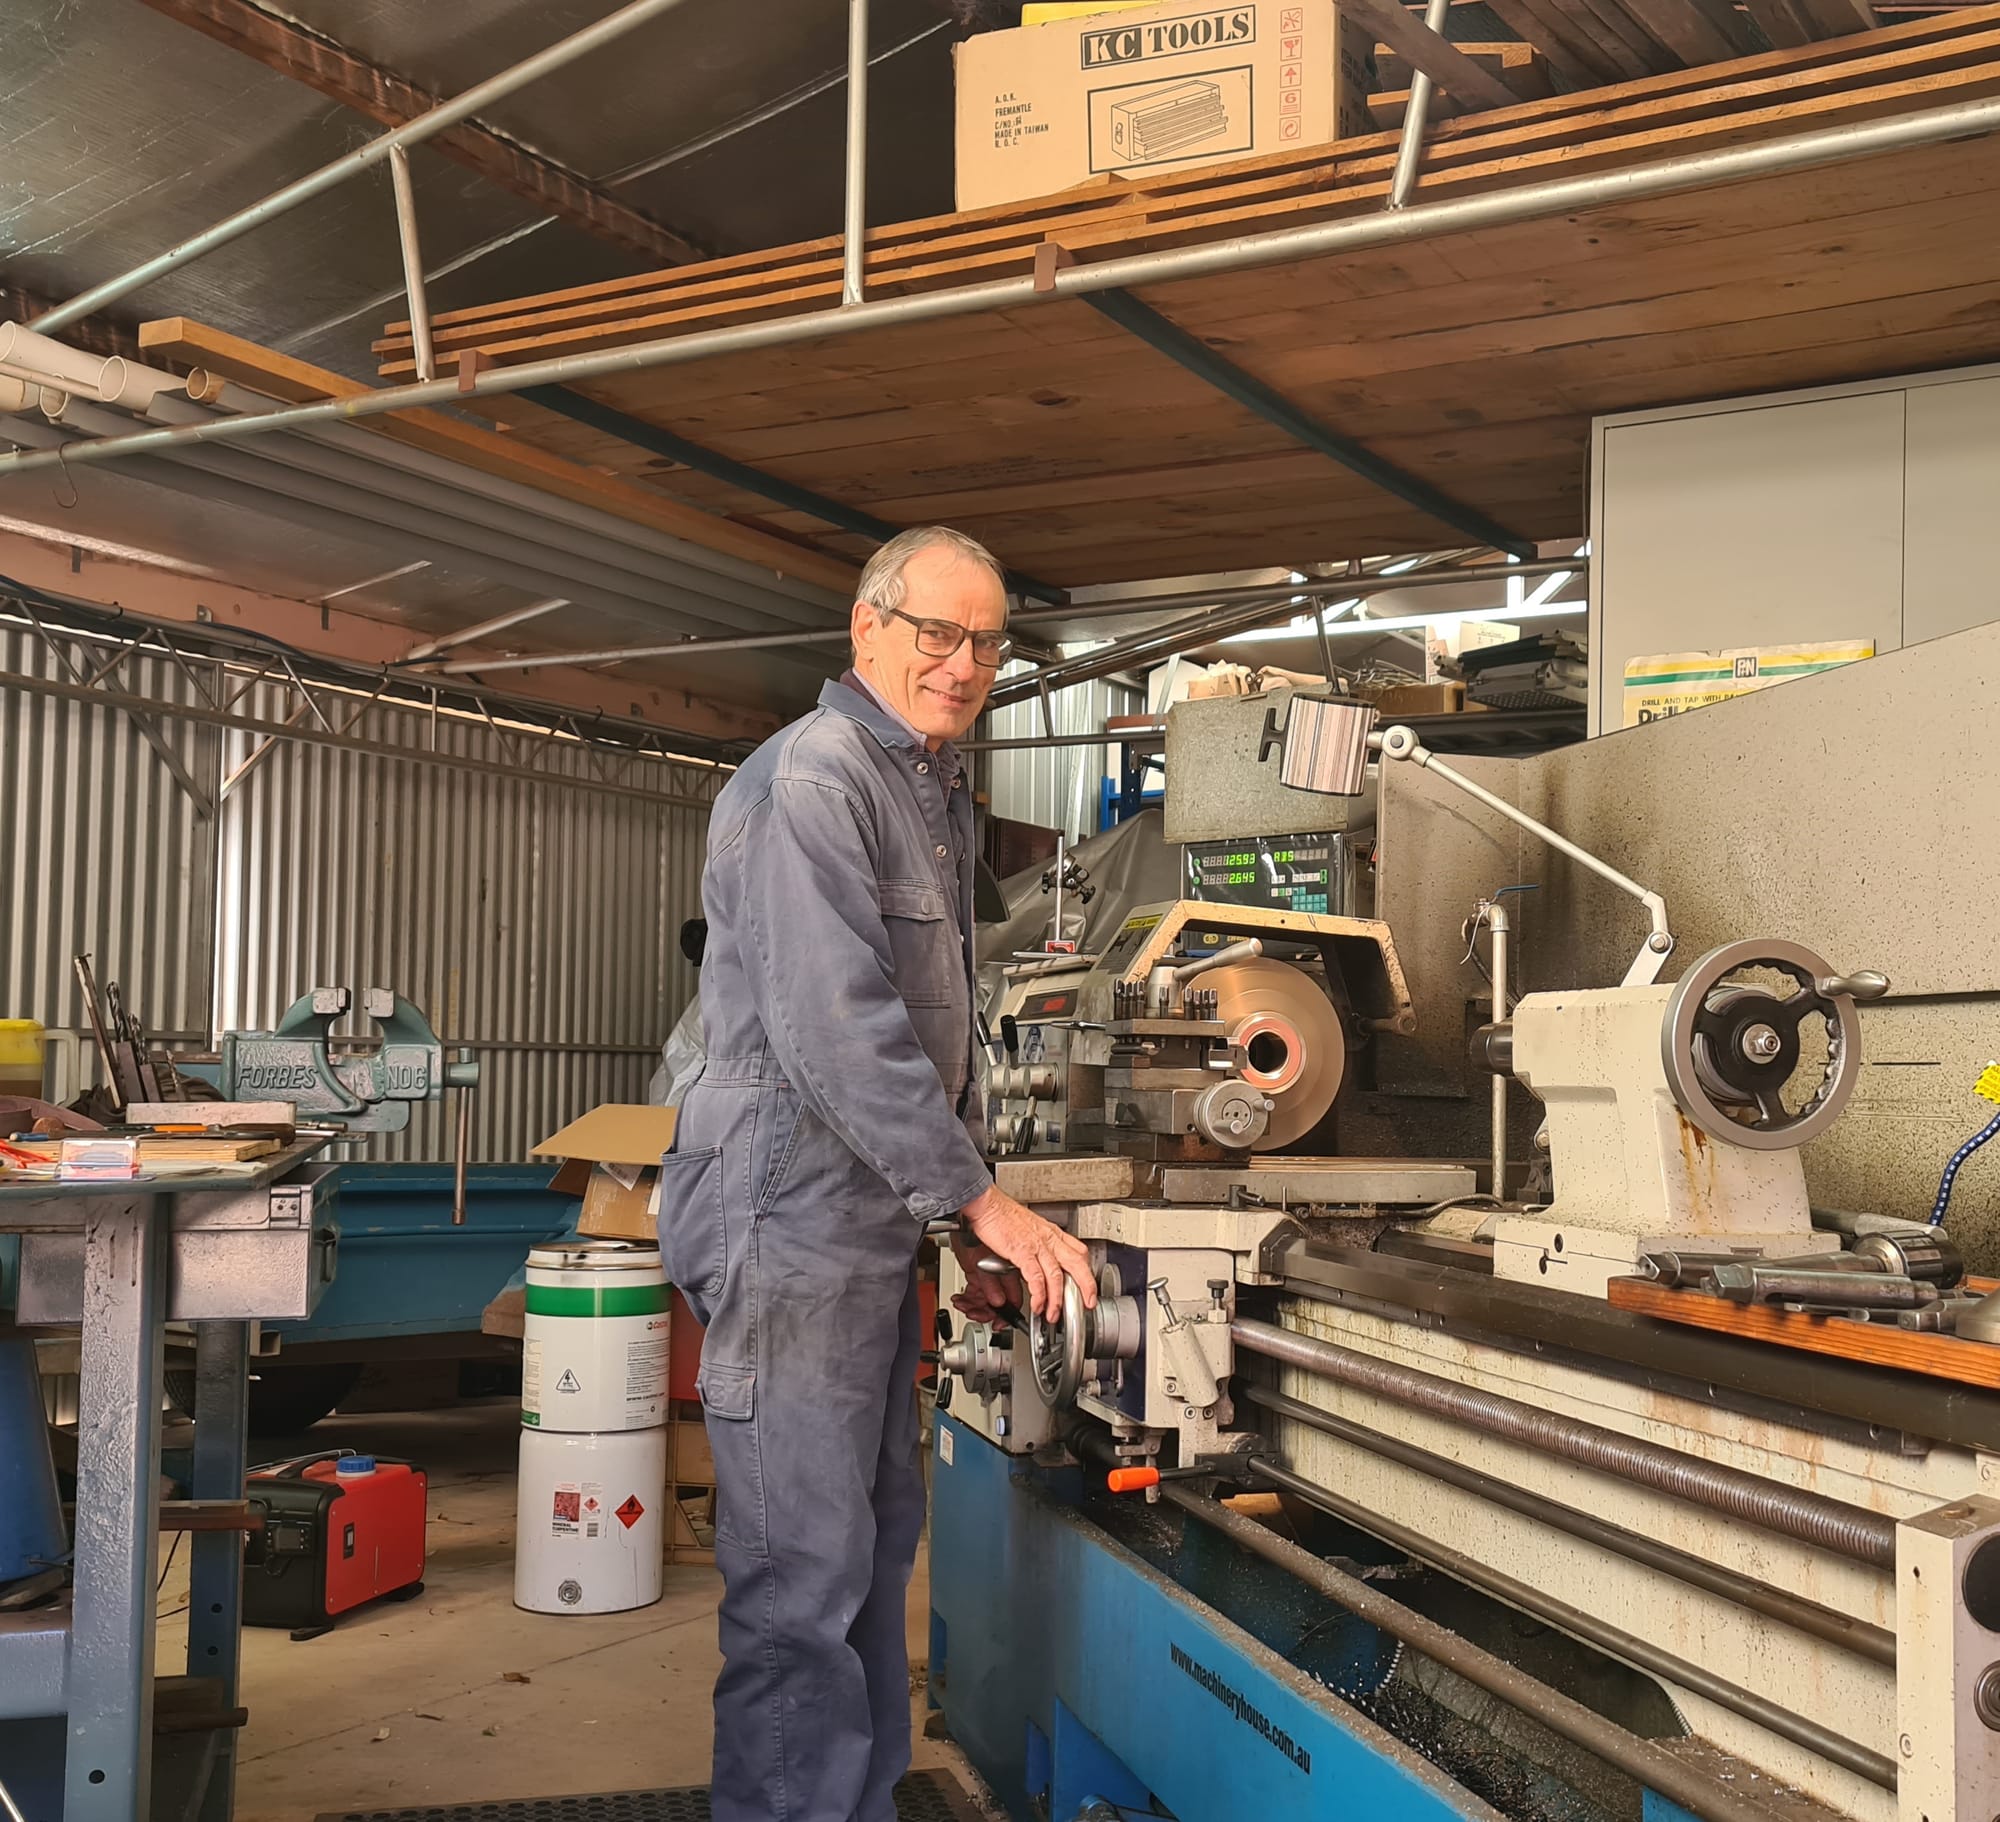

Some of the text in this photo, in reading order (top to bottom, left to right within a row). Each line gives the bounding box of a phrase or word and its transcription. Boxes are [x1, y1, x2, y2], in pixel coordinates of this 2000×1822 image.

[1088, 12, 1250, 64] KC TOOLS
[995, 102, 1032, 118] FREMANTLE
[995, 123, 1049, 139] MADE IN TAIWAN
[1641, 699, 1660, 707] DRILL
[1664, 697, 1681, 705] AND
[1684, 696, 1699, 704] TAP
[1702, 694, 1721, 703] WITH
[235, 1065, 319, 1089] FORBES
[1170, 1642, 1311, 1775] www.machineryhouse.com.au
